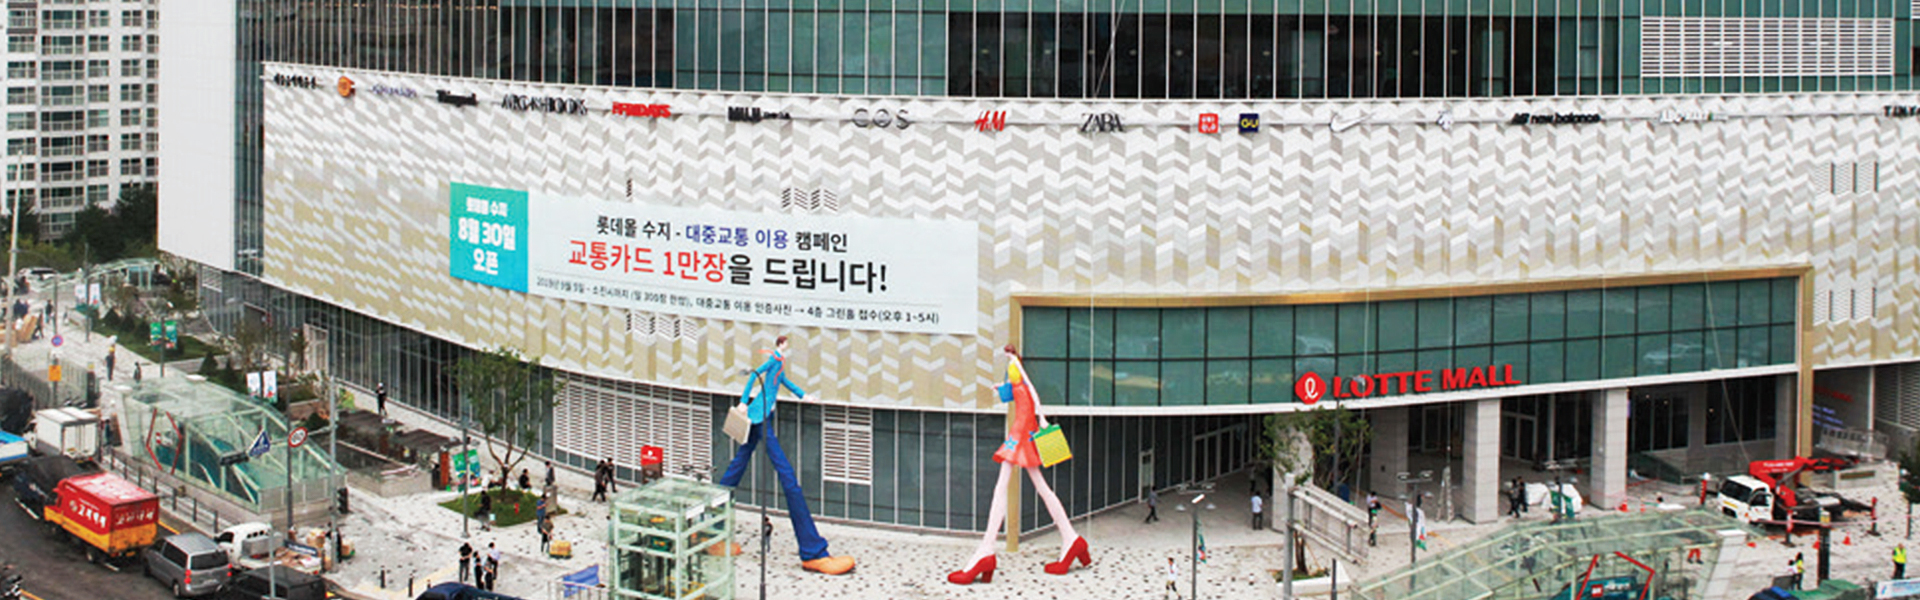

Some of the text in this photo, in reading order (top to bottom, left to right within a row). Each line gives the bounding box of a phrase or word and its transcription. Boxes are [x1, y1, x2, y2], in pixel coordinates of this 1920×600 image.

[852, 108, 909, 129] COS
[974, 110, 1006, 132] H&M
[1080, 113, 1125, 132] ZARA
[1241, 118, 1258, 128] GU
[1554, 112, 1601, 124] balance
[458, 217, 516, 251] 8월 30일
[597, 215, 636, 238] 롯데몰
[642, 219, 671, 241] 수지
[685, 223, 749, 247] 대중교통
[755, 228, 789, 250] 이용
[795, 231, 848, 253] 캠페인
[473, 248, 499, 275] 오픈
[568, 239, 887, 293] 교통카드 1만장을 드립니다!
[696, 297, 731, 311] 대중교통
[734, 300, 751, 313] 이용
[754, 303, 792, 316] 인증사진
[807, 306, 822, 318] 4층
[1333, 363, 1522, 399] LOTTE MALL
